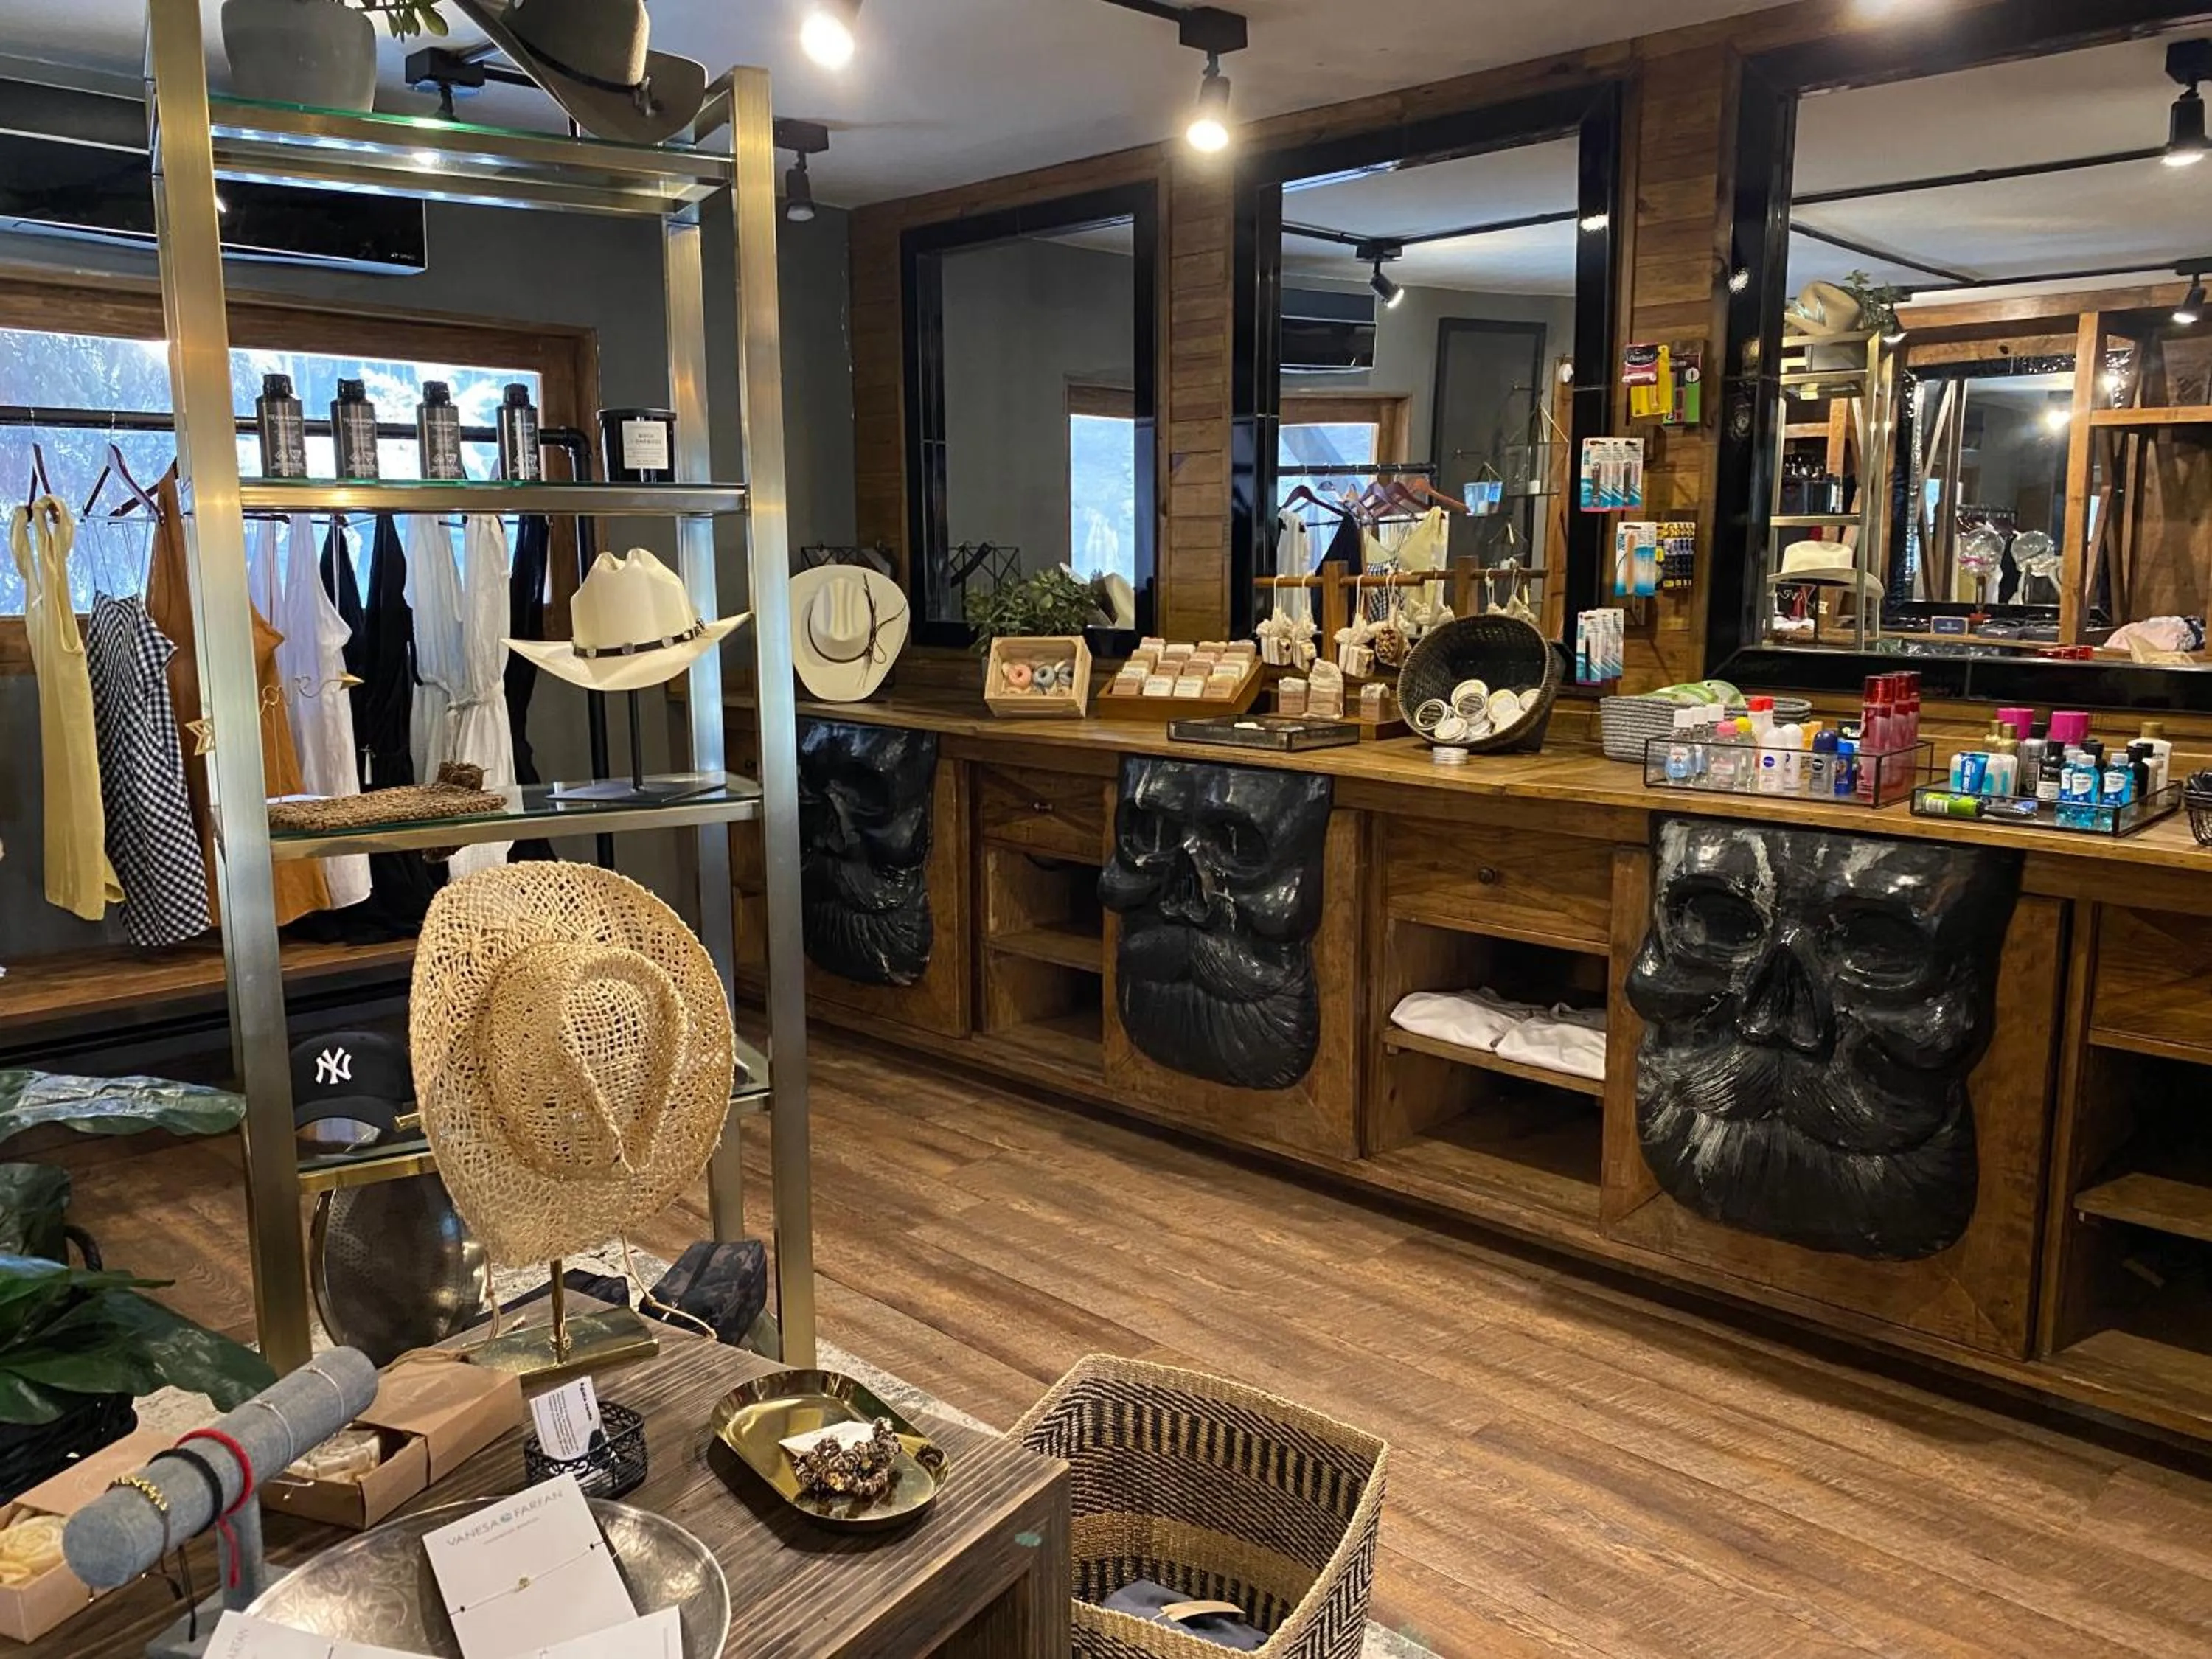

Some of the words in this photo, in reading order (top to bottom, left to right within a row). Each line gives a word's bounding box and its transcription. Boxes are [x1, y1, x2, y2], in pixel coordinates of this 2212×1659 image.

[315, 1047, 352, 1085] NY
[446, 1518, 502, 1546] VANESA
[514, 1489, 563, 1518] FARFAN
